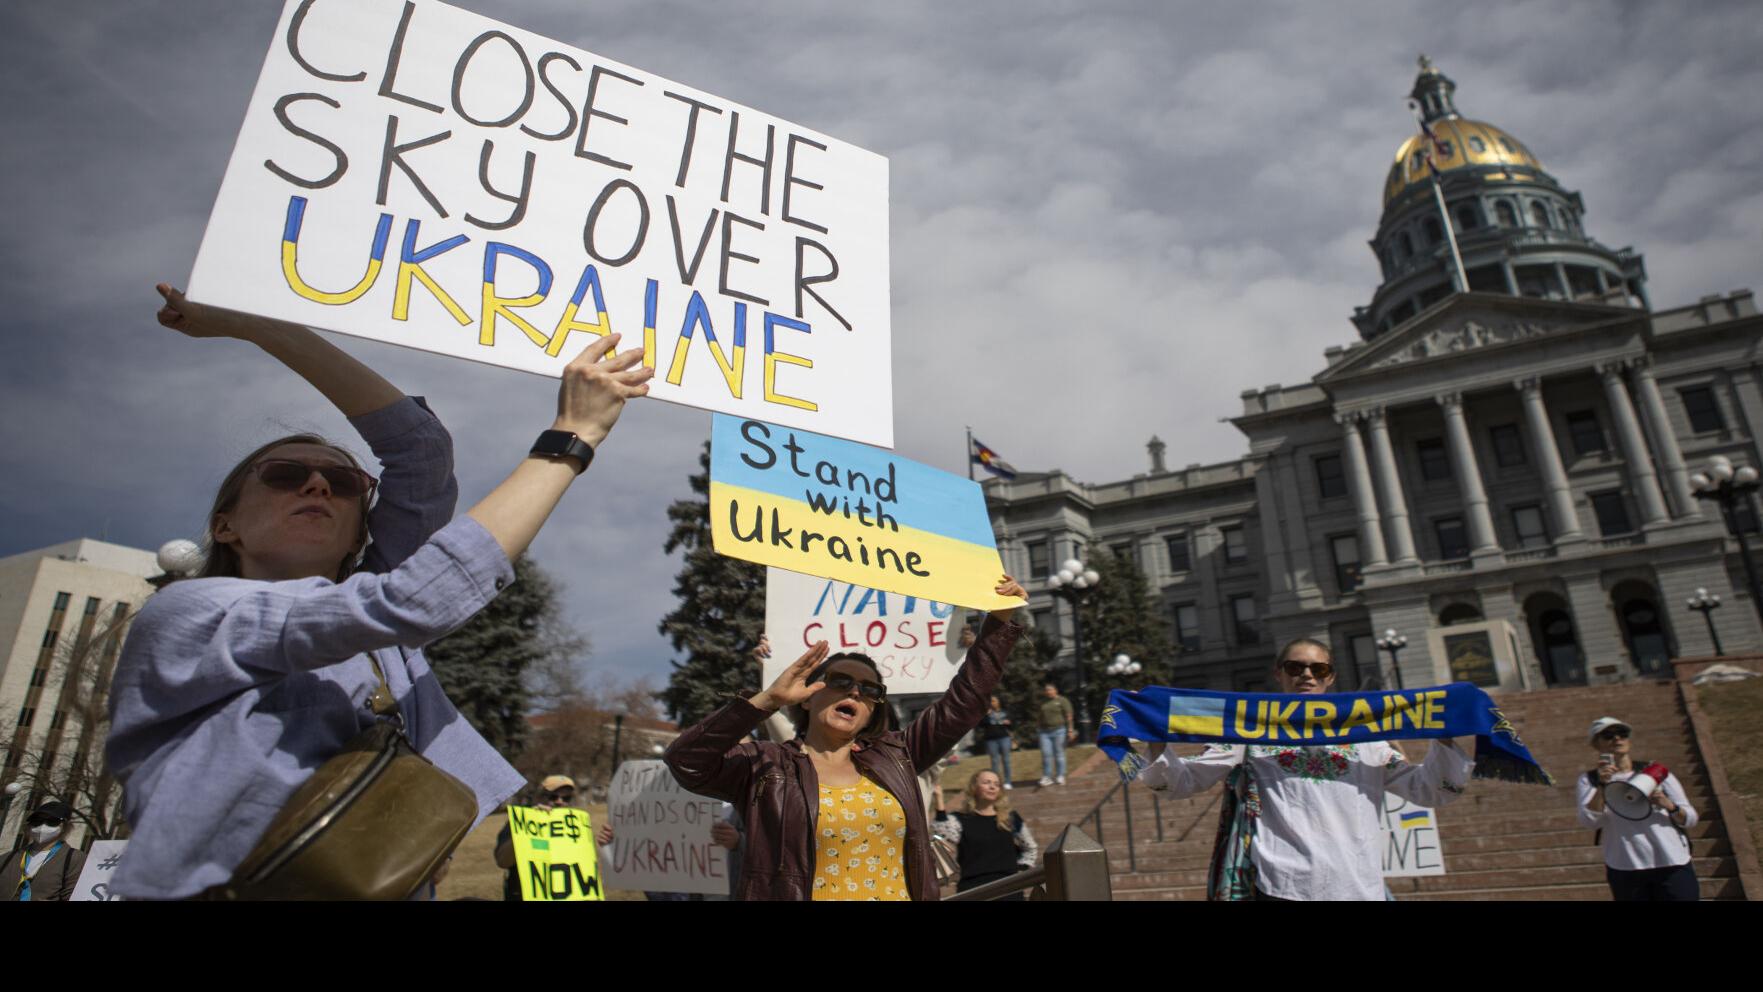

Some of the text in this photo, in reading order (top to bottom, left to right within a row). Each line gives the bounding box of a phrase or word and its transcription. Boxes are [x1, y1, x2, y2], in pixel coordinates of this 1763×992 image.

[287, 0, 828, 234] CLOSE THE
[264, 92, 853, 331] SKY OVER
[281, 195, 819, 412] UKRAINE
[740, 420, 898, 504] Stand
[805, 488, 899, 532] with
[729, 499, 931, 577] Ukraine
[802, 620, 947, 650] CLOSE
[880, 654, 935, 681] SKY
[1233, 690, 1448, 740] UKRAINE
[613, 800, 723, 826] HANDS OFF
[528, 860, 600, 901] NOW
